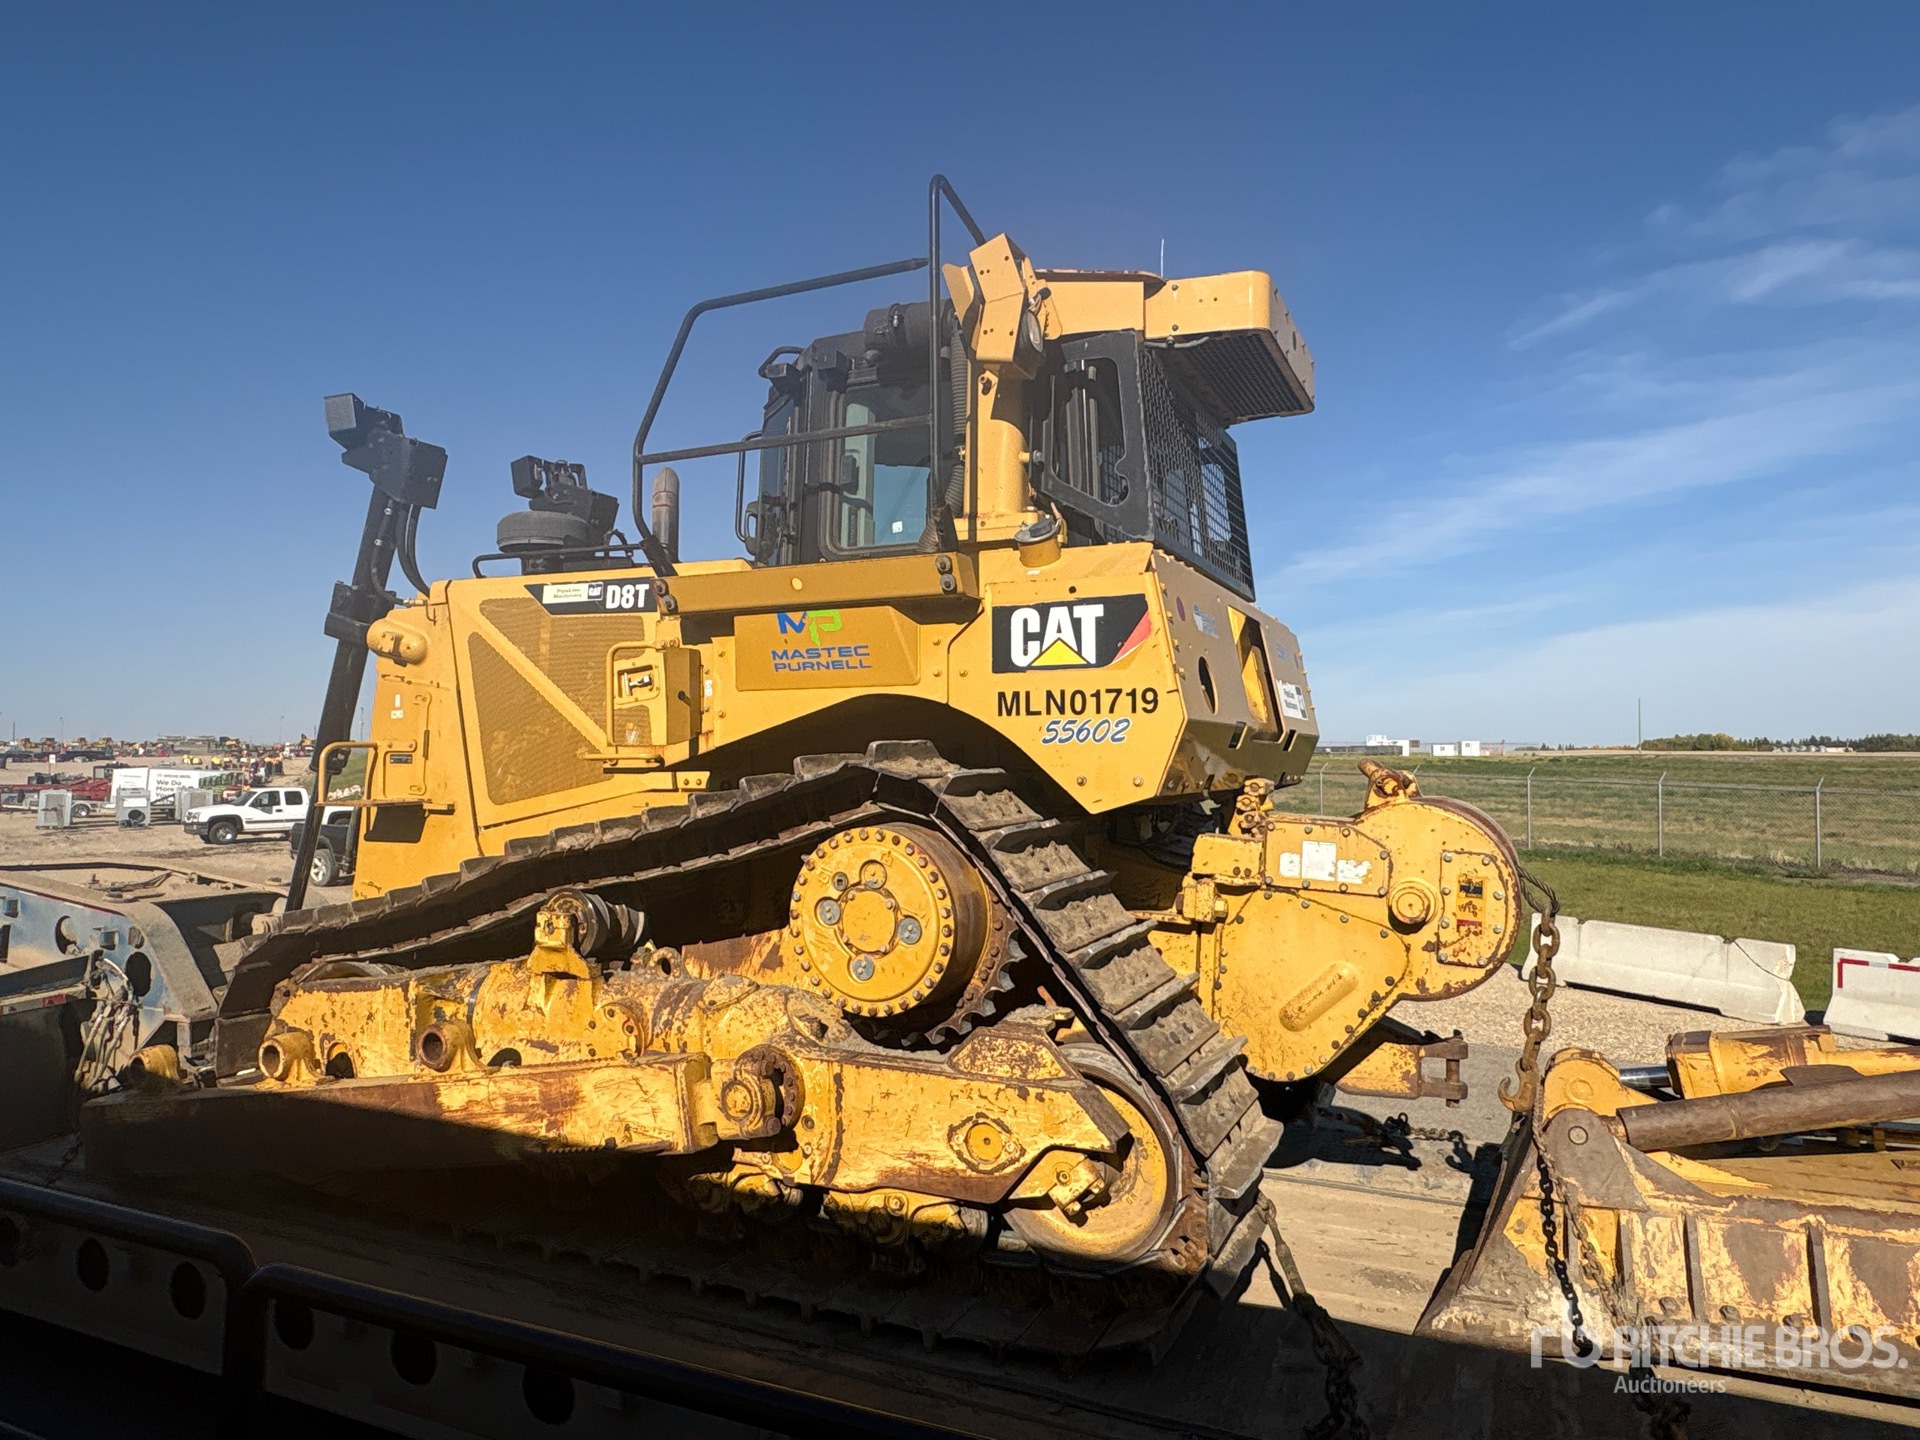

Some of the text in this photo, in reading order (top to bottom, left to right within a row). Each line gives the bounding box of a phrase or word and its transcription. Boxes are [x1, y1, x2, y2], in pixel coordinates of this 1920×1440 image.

[588, 586, 602, 597] CAT
[606, 584, 649, 609] D8T
[1010, 604, 1104, 667] CAT
[771, 645, 871, 661] MASTEC
[774, 659, 873, 673] PURNELL
[997, 687, 1158, 717] MLN01719
[1041, 718, 1131, 744] 55602
